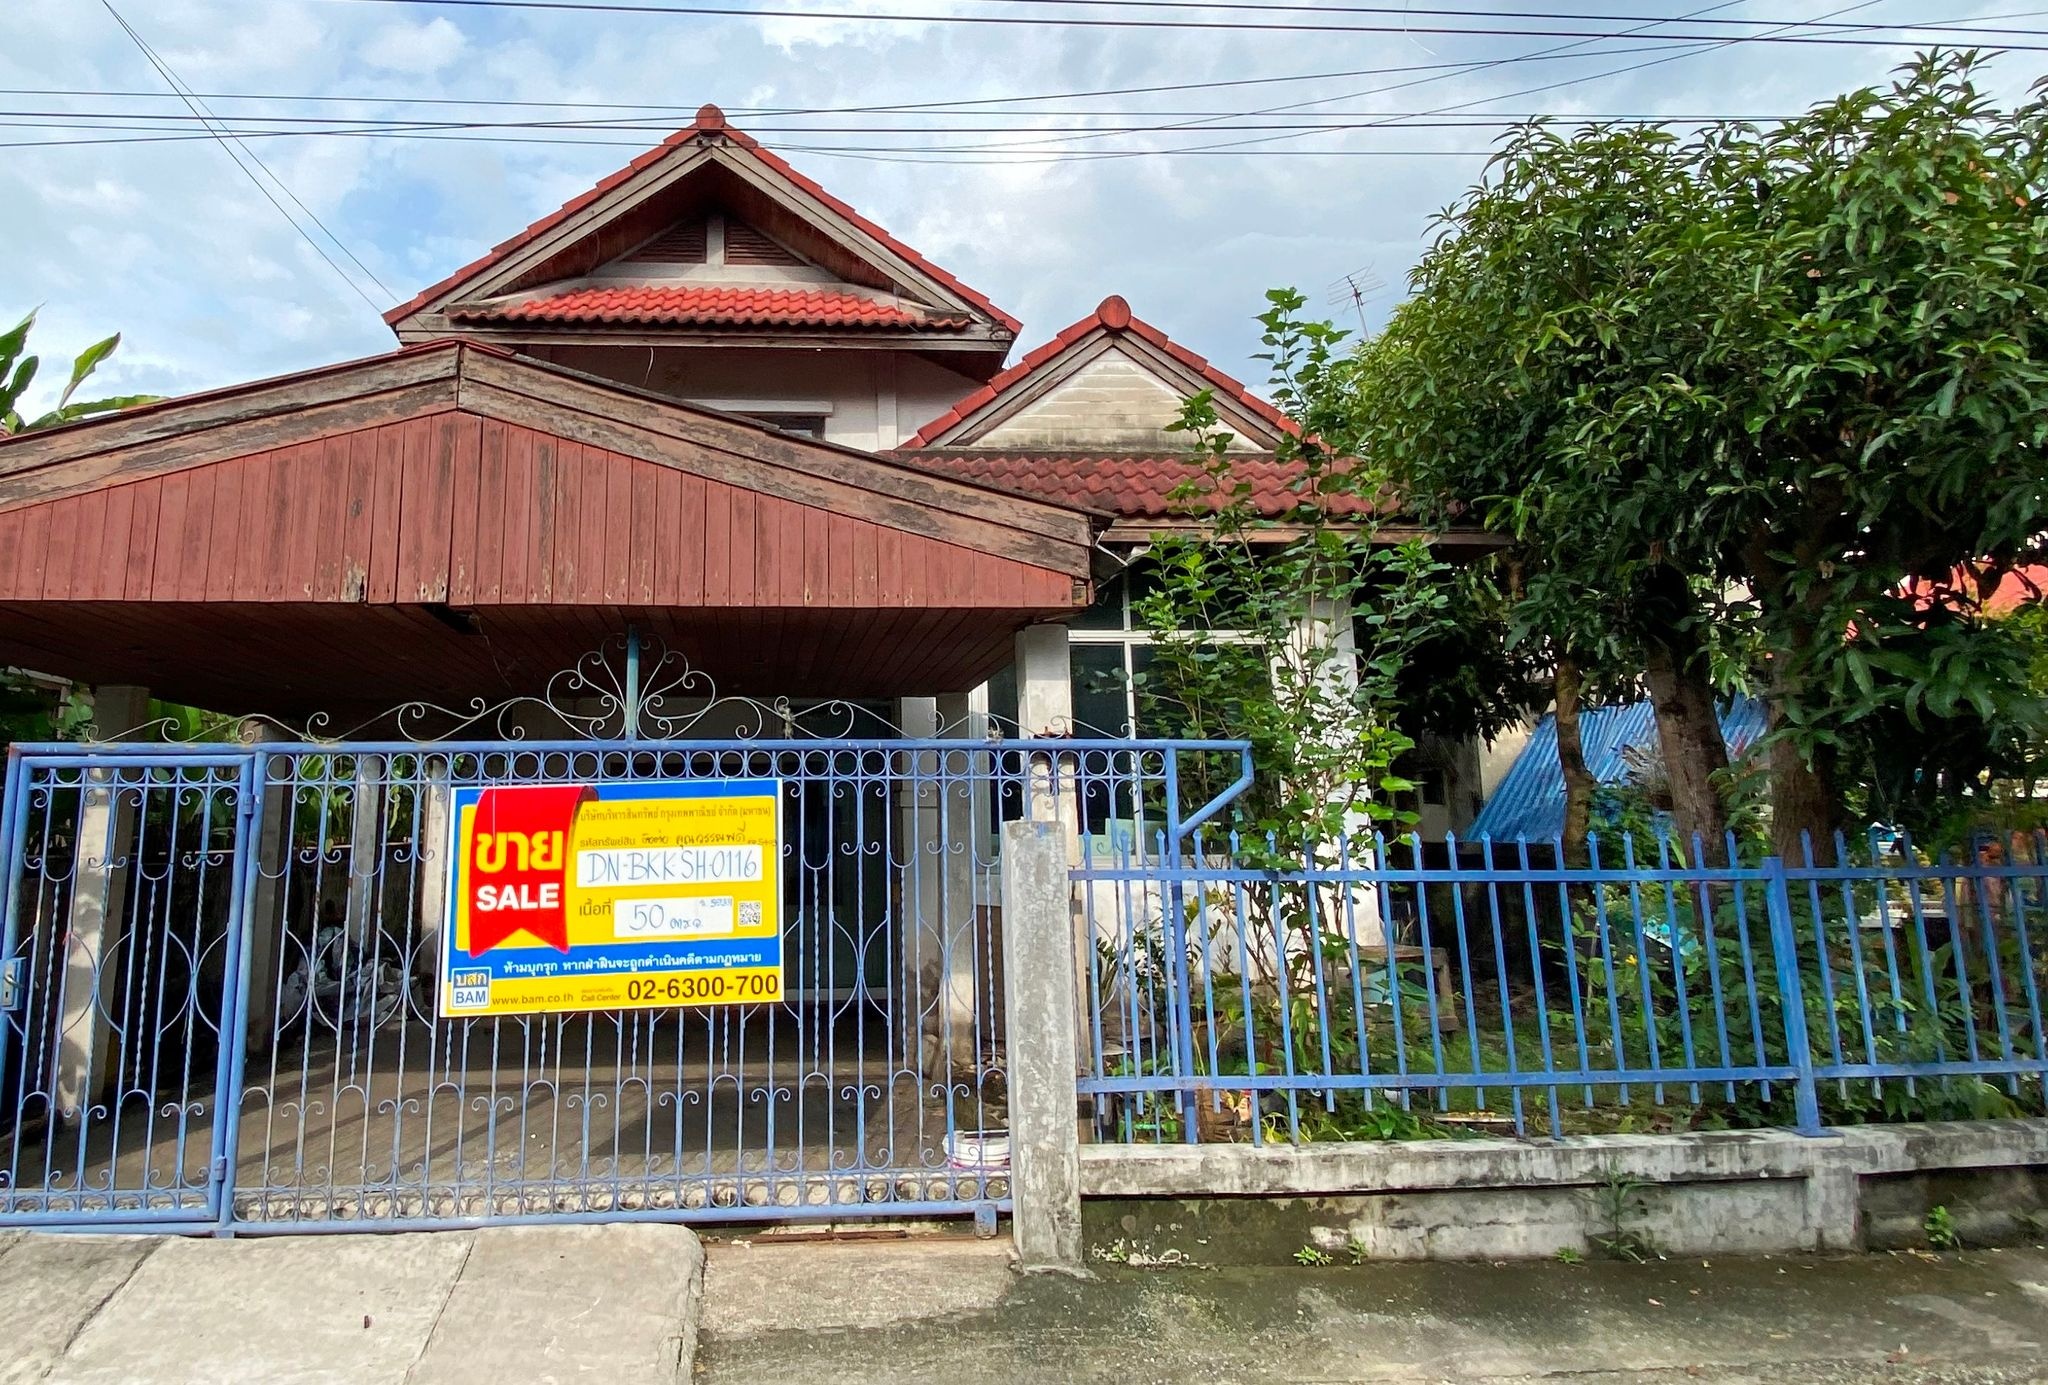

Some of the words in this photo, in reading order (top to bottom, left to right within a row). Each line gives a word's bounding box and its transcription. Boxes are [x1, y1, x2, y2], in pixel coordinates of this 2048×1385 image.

[718, 804, 738, 817] จำกัด
[739, 805, 771, 818] (มหาชน)
[580, 835, 636, 848] รหัสทรัพย์สิน
[476, 830, 563, 874] ขาย
[476, 882, 560, 912] SALE
[579, 898, 612, 916] เนื้อที่
[629, 904, 665, 931] 50
[503, 961, 558, 976] ห้ามบุกรุก
[456, 972, 487, 987] บสก
[627, 974, 779, 1001] 02-6300-700
[456, 990, 486, 1004] BAM
[492, 993, 574, 1005] www.bam.co.th
